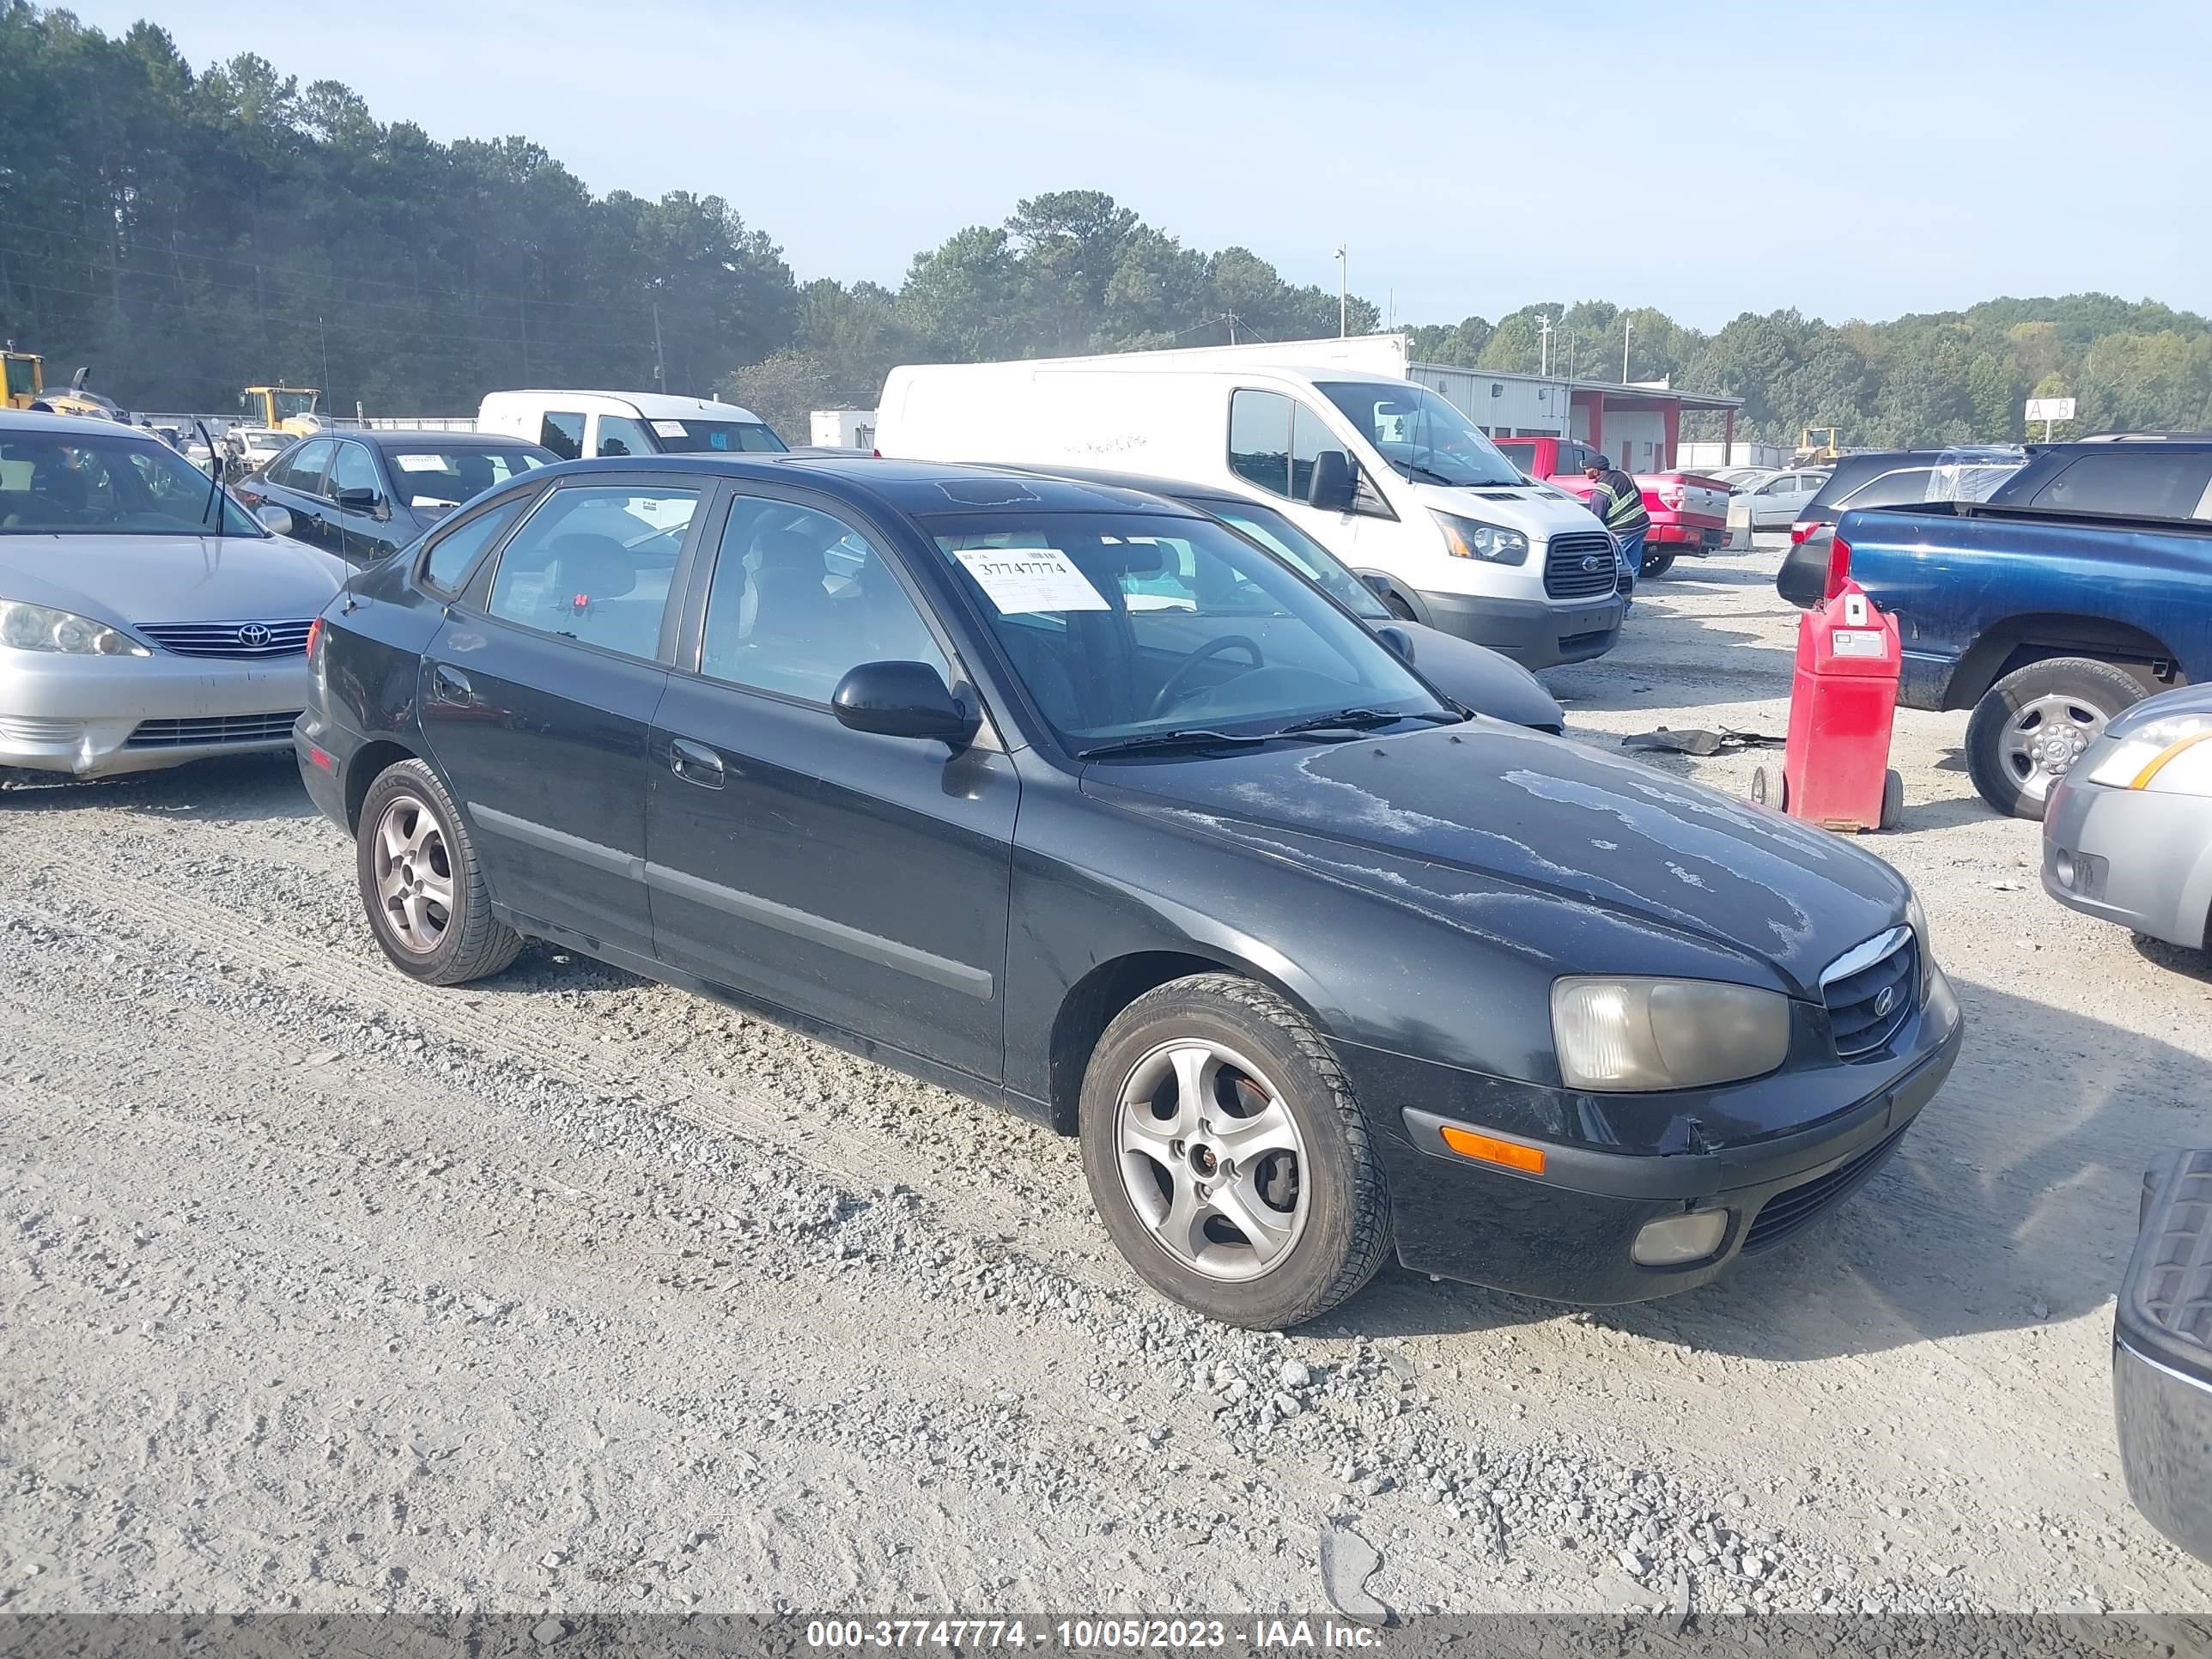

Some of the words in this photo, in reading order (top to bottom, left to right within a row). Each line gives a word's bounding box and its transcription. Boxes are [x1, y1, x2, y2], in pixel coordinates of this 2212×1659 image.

[2029, 401, 2041, 419] A
[2059, 400, 2068, 418] B
[978, 562, 1066, 575] 37747774
